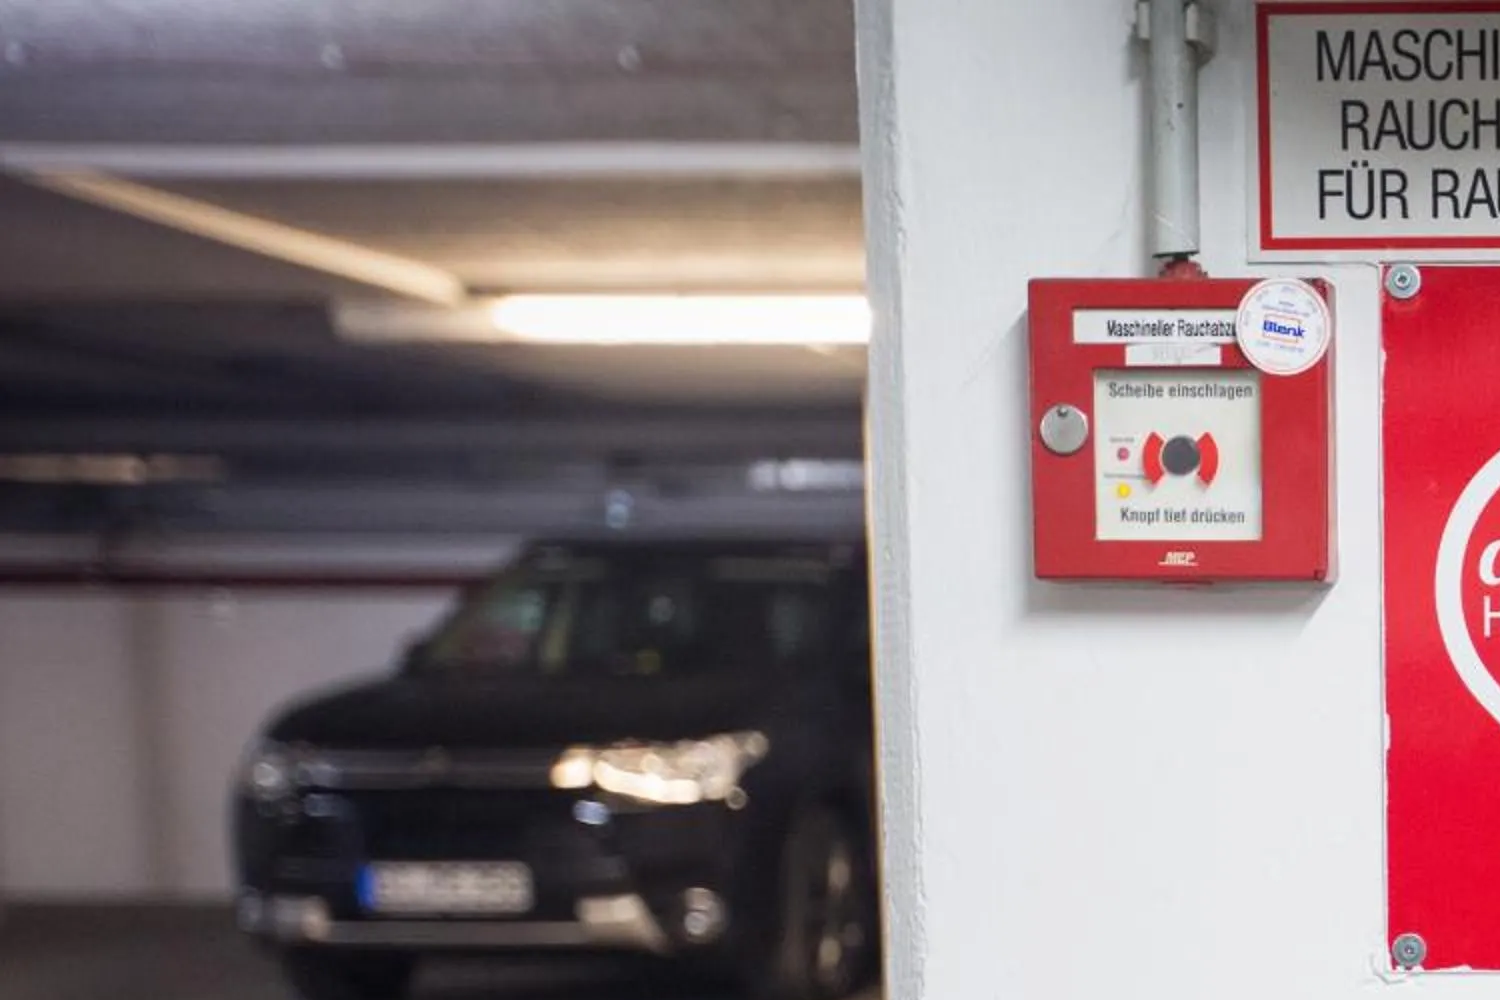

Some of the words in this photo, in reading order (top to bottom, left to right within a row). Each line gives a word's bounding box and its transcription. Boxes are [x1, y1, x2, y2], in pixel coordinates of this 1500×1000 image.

[1317, 160, 1409, 220] FÜR
[1107, 319, 1175, 337] Maschineller
[1108, 382, 1164, 398] Scheibe
[1168, 383, 1253, 400] einschlagen
[1119, 507, 1161, 525] Knopf
[1163, 508, 1187, 523] tief
[1190, 508, 1245, 524] drücken
